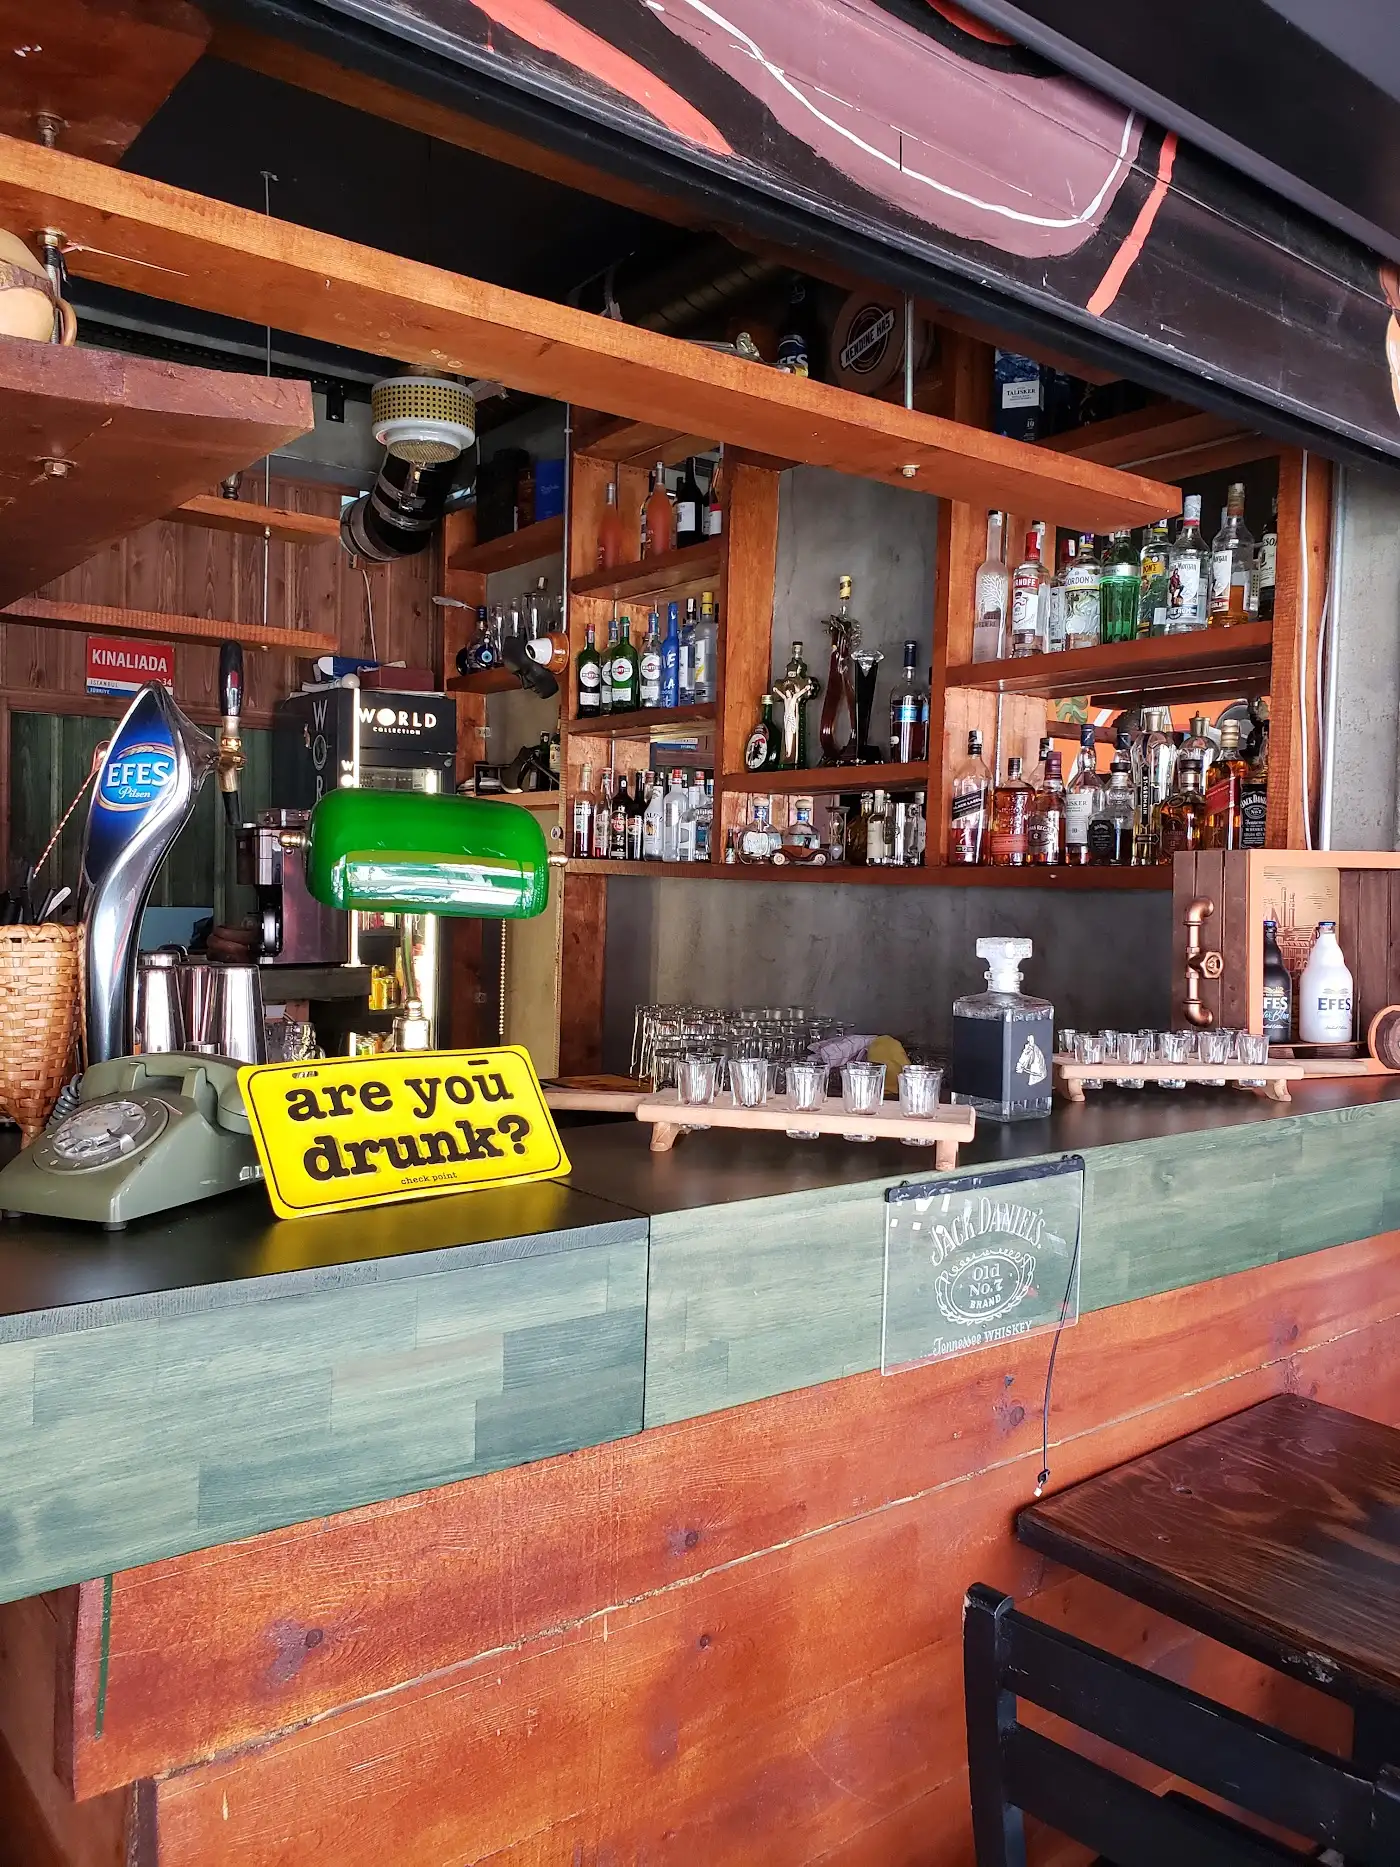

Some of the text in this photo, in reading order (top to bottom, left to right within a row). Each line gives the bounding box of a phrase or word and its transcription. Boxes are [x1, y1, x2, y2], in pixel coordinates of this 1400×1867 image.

[1006, 388, 1036, 396] TALISKER
[92, 648, 168, 673] KINALIADA
[162, 677, 172, 687] 34
[358, 707, 437, 728] WORLD
[372, 726, 421, 736] COLLECTION
[106, 761, 170, 787] EFES
[118, 786, 151, 799] Pilsen
[1263, 996, 1288, 1010] FES
[1317, 997, 1351, 1011] EFES
[285, 1072, 513, 1121] are you
[303, 1115, 531, 1181] drunk?
[400, 1172, 458, 1185] check point
[930, 1208, 976, 1267] JACK
[971, 1263, 1001, 1282] Old
[969, 1294, 1001, 1309] BRAND
[932, 1320, 1033, 1357] Tennessee WHISKEY
